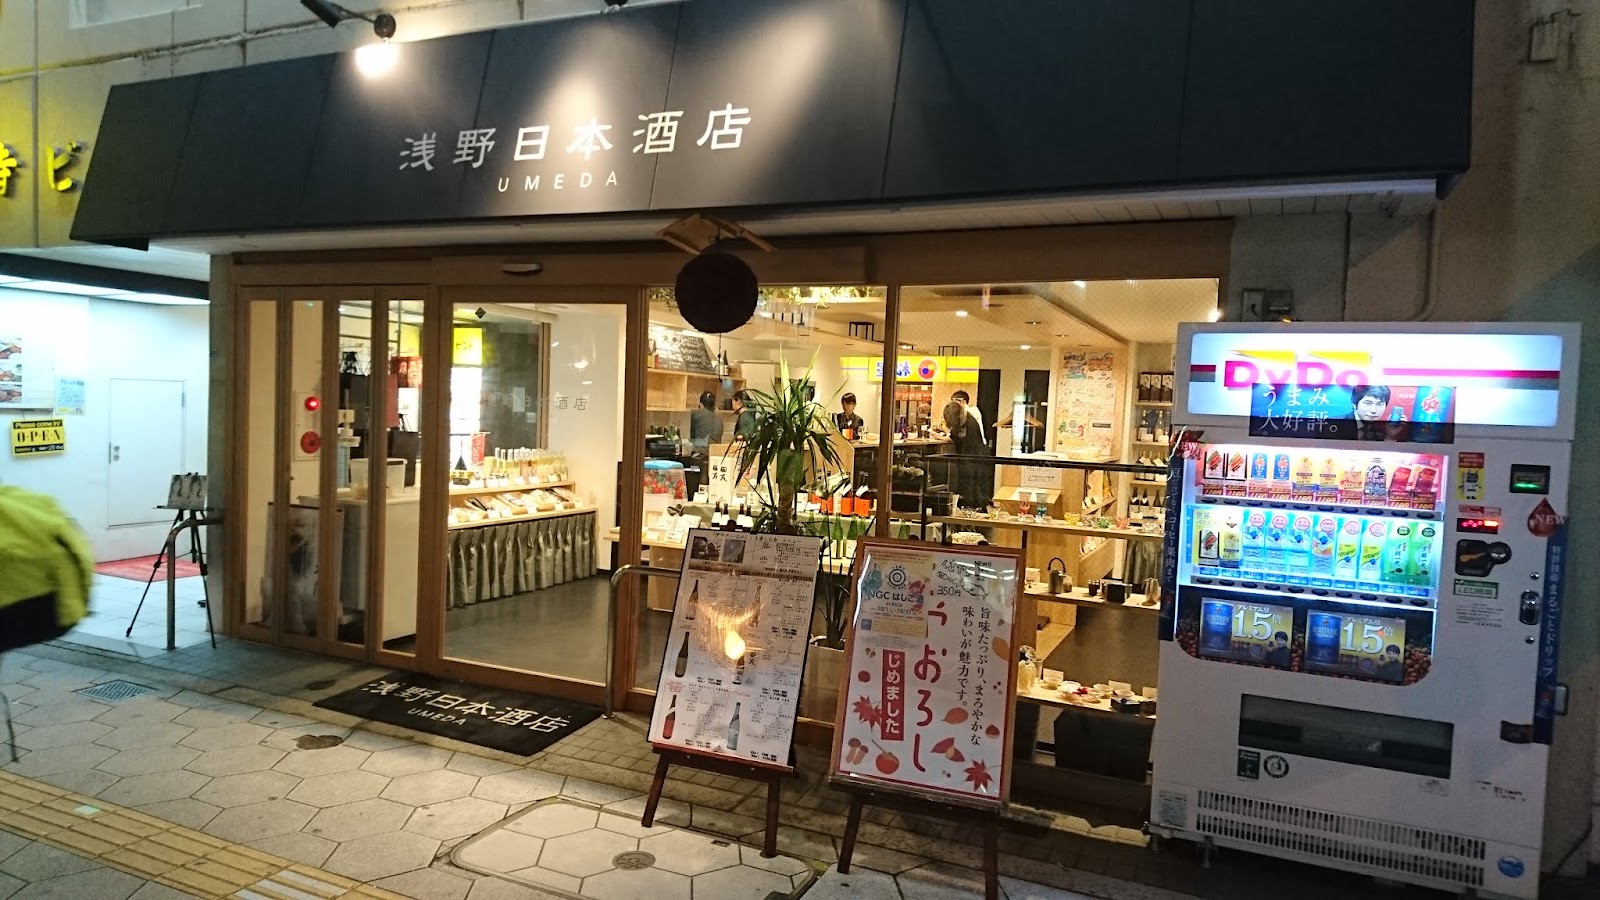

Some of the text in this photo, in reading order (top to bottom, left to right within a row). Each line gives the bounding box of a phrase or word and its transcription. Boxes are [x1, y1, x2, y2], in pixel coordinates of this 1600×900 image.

[399, 103, 752, 172] 浅野日本酒店
[497, 170, 620, 192] UMEDA
[1223, 360, 1369, 388] DyDo
[1263, 385, 1330, 407] うまみ
[1258, 408, 1338, 433] 大好評。
[1534, 513, 1567, 525] NEW
[937, 585, 961, 597] 350円
[956, 605, 976, 706] 味わいが魅力です。
[969, 606, 992, 746] 旨味たっぷり、まろやかな
[361, 680, 570, 733] 浅野日本酒店
[407, 707, 467, 726] UMEDA
